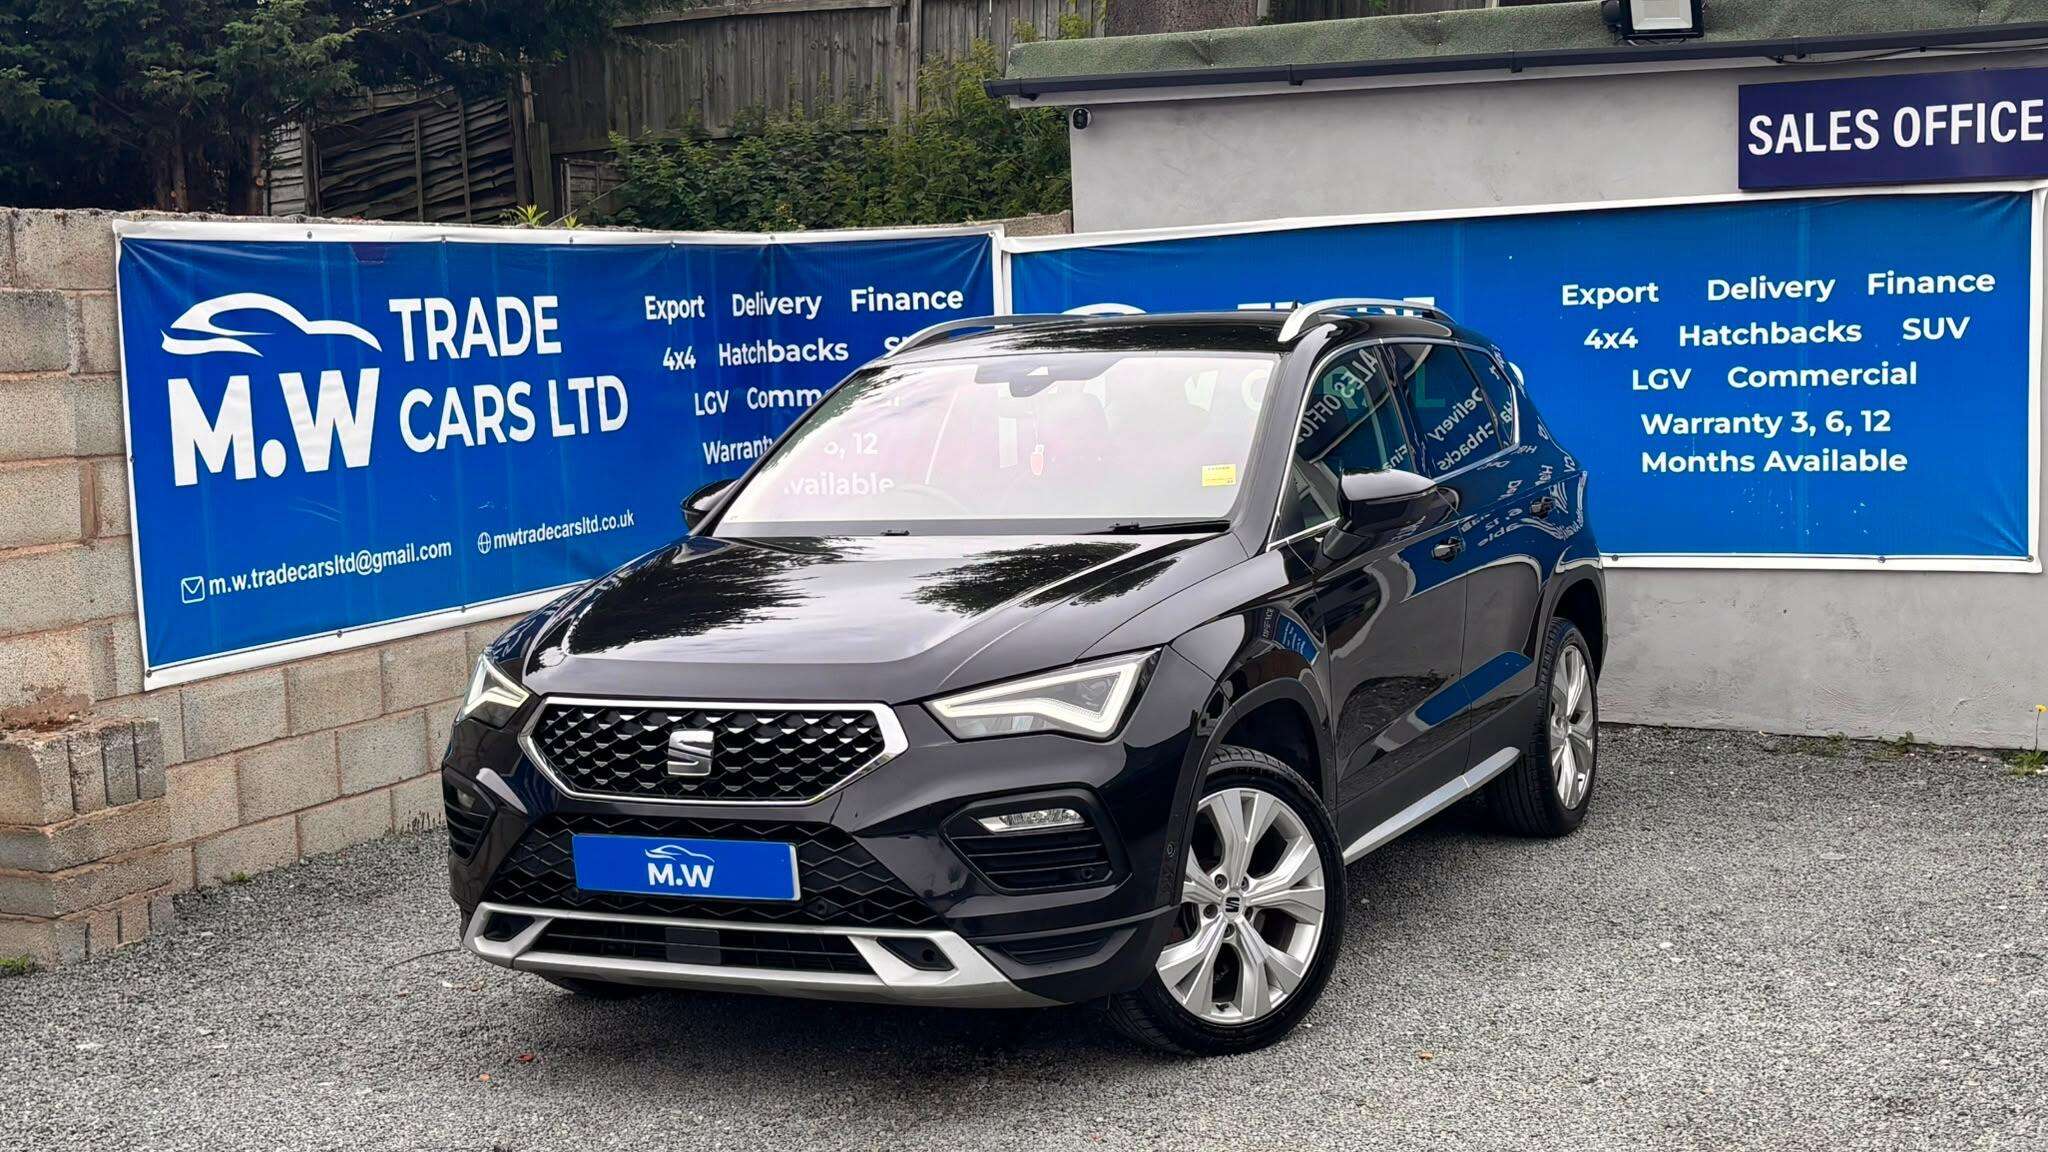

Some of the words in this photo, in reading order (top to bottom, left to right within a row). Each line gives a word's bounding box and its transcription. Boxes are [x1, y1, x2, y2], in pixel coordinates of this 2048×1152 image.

[1748, 108, 1880, 156] SALES
[1893, 98, 2044, 148] OFFICE
[644, 295, 706, 325] Export
[732, 290, 822, 320] Delivery
[850, 286, 964, 312] Finance
[1562, 282, 1660, 310] Export
[1707, 275, 1836, 303] Delivery
[1868, 270, 1996, 296] Finance
[389, 295, 562, 362] TRADE
[1583, 327, 1639, 350] 4x4
[1679, 319, 1862, 347] Hatchbacks
[1902, 316, 1971, 341] SUV
[662, 345, 697, 371] 4x4
[718, 337, 849, 367] Hatchbacks
[1632, 368, 1692, 391] LGV
[1727, 360, 1917, 389] Commercial
[399, 380, 536, 453] CARS
[548, 375, 629, 437] LTD
[694, 389, 730, 416] LGV
[746, 386, 829, 410] Comm
[167, 367, 380, 487] M.W
[1640, 411, 1783, 438] Warranty
[1790, 411, 1817, 437] 3,
[1825, 410, 1853, 437] 6,
[1860, 409, 1891, 432] 12
[1642, 449, 1756, 473] Months
[1763, 447, 1908, 472] Available
[783, 471, 895, 496] vailable
[493, 509, 635, 550] mwtradecarsltd.co.uk
[209, 539, 452, 596] m.w.tradecarsltd@gmail.com
[648, 863, 714, 889] M.W
